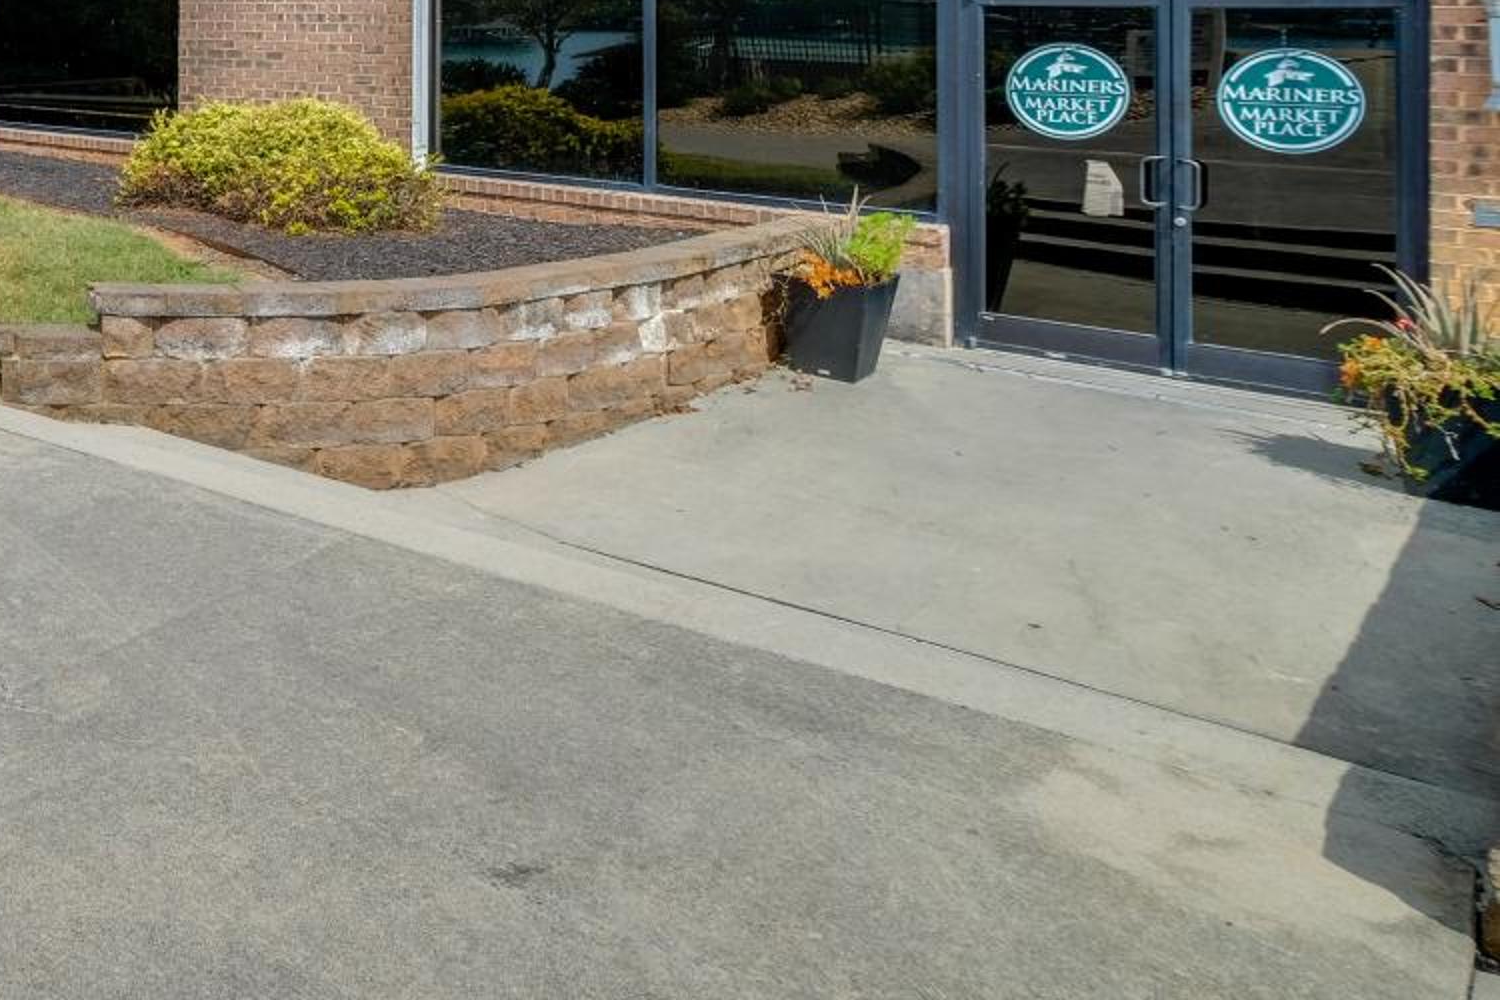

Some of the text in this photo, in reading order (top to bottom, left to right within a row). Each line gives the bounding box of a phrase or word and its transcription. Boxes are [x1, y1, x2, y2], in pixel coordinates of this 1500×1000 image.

[1011, 75, 1126, 95] MARINERS
[1222, 84, 1360, 105] MARINERS
[1025, 97, 1111, 113] MARKET
[1036, 109, 1098, 125] PLACE
[1240, 106, 1342, 124] MARKET
[1254, 121, 1328, 137] PLACE
